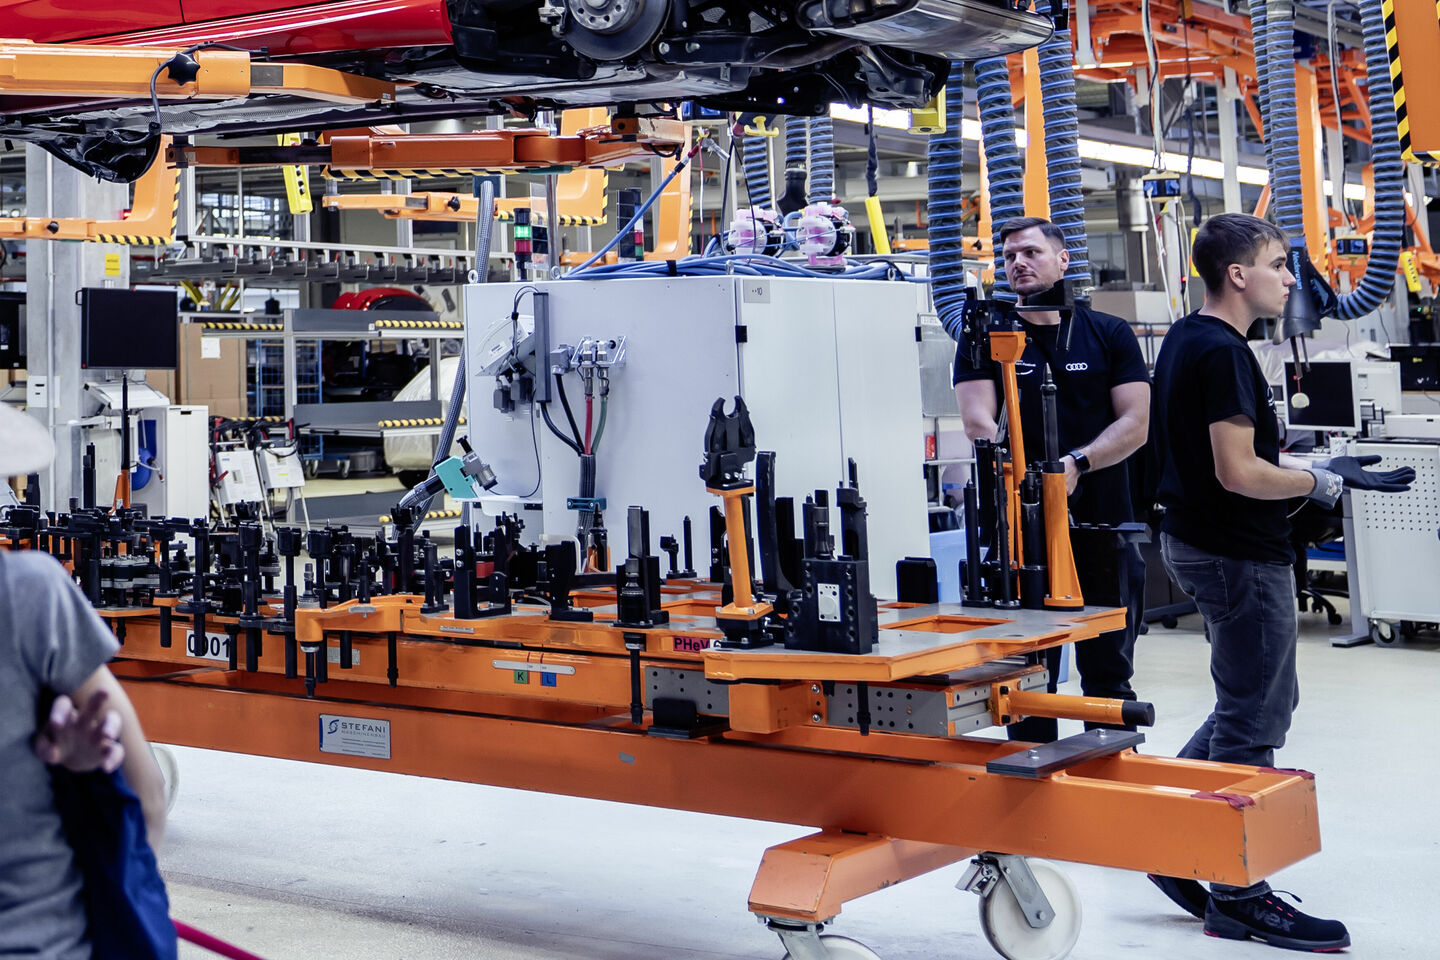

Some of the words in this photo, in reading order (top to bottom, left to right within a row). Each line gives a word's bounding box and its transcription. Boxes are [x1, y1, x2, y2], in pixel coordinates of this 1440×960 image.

[674, 637, 710, 651] PHeV
[517, 671, 524, 681] K
[546, 674, 553, 685] L
[341, 722, 386, 733] STEFANI
